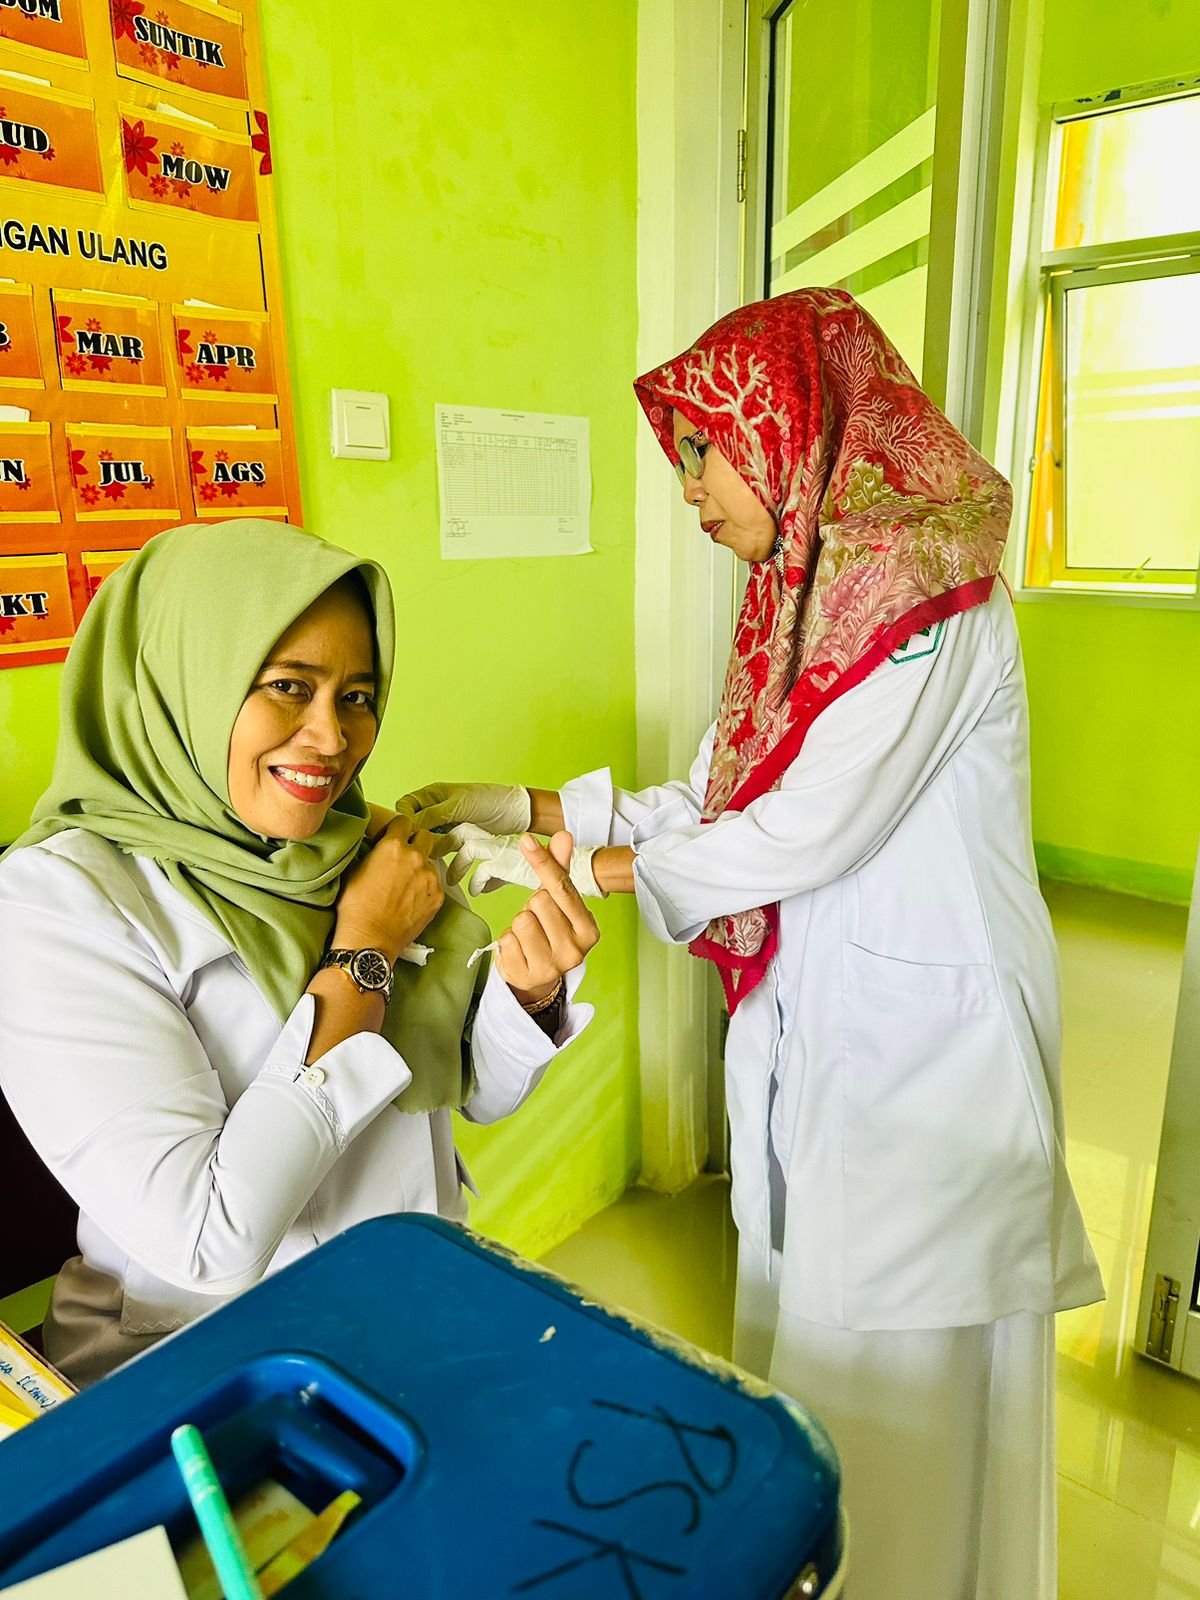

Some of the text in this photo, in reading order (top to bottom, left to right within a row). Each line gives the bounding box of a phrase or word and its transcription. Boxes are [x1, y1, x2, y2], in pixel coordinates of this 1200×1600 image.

[0, 0, 61, 22] OM
[134, 16, 224, 67] SUNTIK
[0, 120, 49, 152] UD
[161, 153, 230, 190] MOW
[0, 220, 168, 270] GAN ULANG
[76, 331, 144, 359] MAR
[196, 343, 256, 368] APR
[0, 459, 25, 483] N
[99, 461, 149, 485] JUL
[213, 462, 265, 483] AGS
[0, 592, 48, 616] KT
